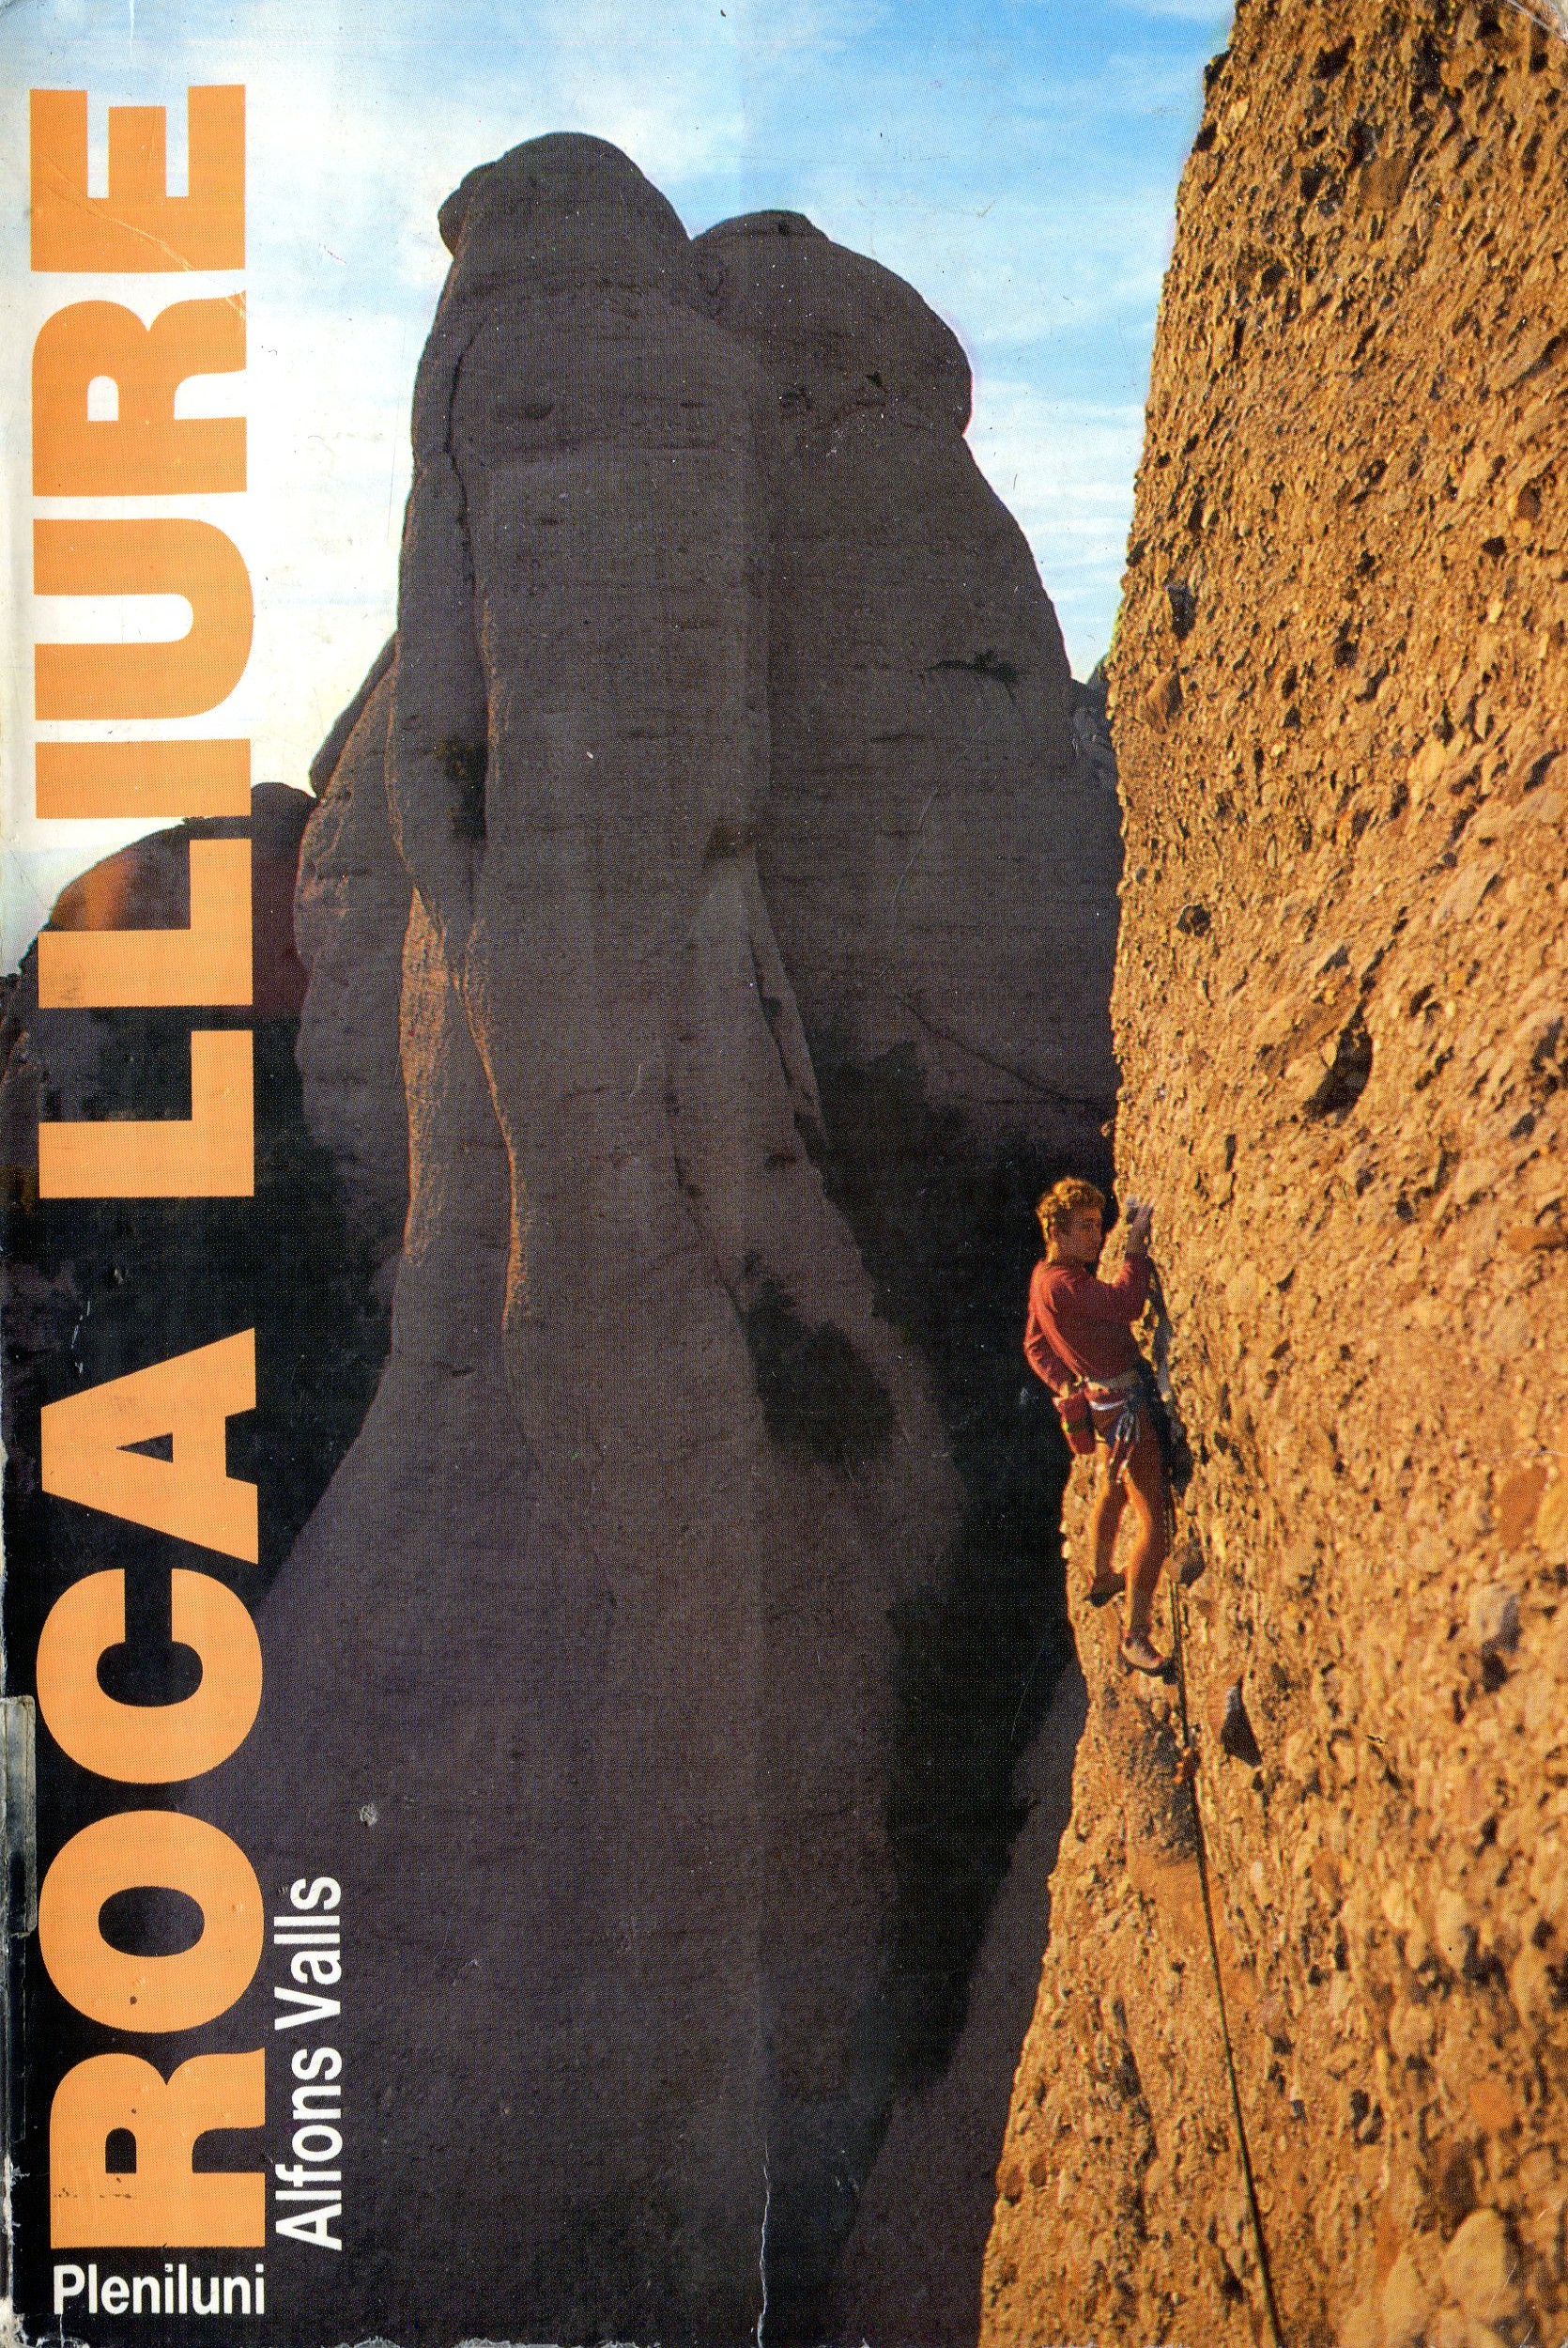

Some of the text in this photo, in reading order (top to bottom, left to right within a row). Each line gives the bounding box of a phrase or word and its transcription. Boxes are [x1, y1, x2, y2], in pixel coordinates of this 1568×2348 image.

[30, 85, 265, 2248] ROCA LLIURE
[274, 1877, 342, 2250] Alfons Valls
[54, 2263, 265, 2315] Pleniluni
